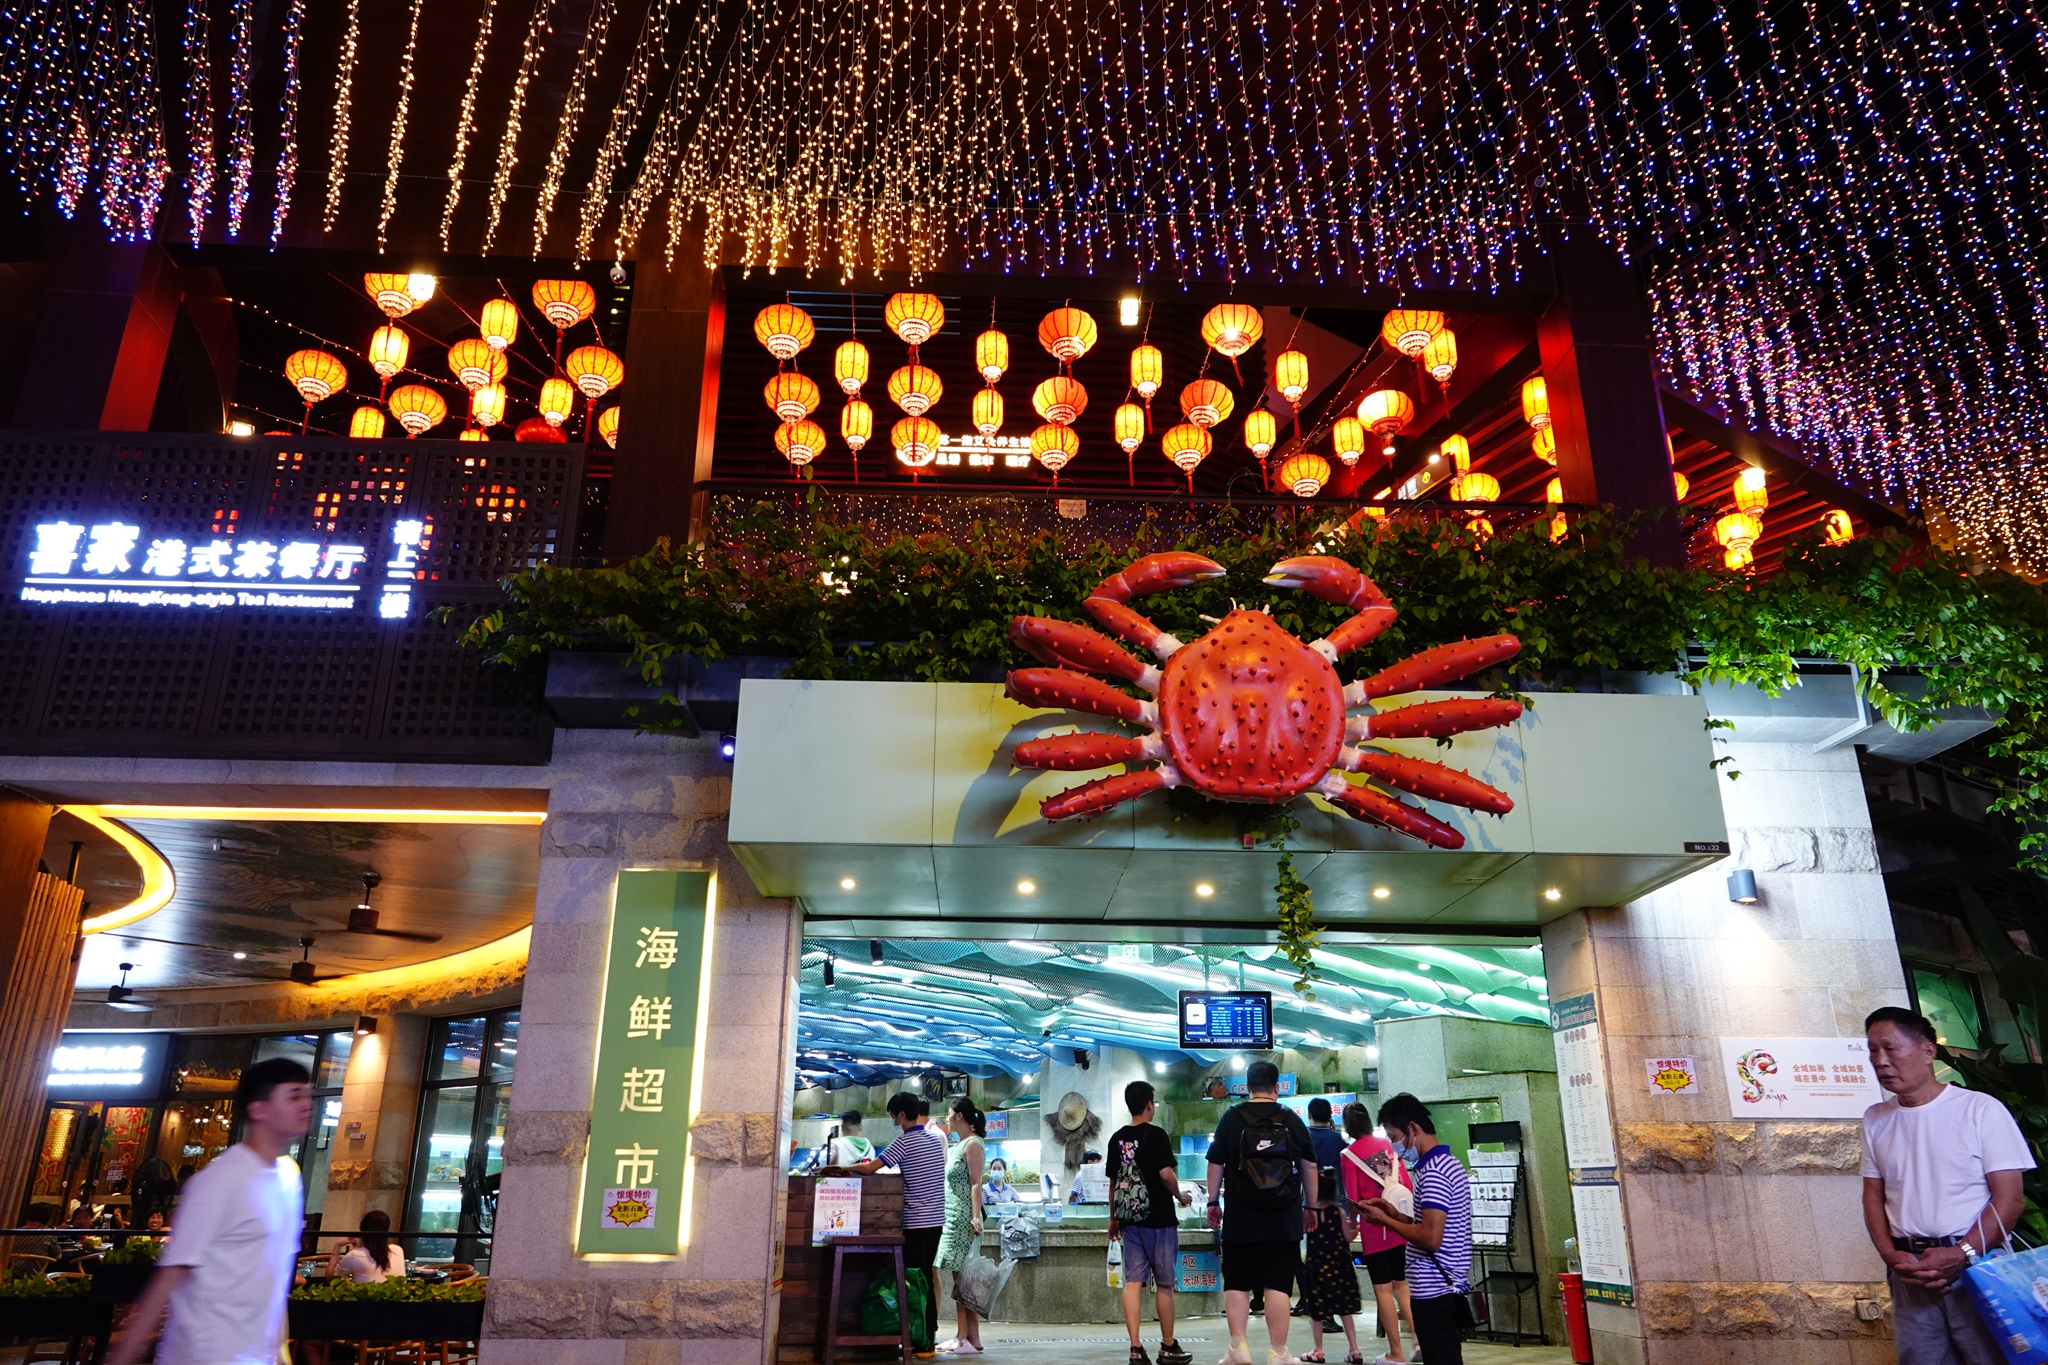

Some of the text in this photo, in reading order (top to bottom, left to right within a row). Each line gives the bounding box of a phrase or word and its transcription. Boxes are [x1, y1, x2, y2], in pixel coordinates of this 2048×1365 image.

[21, 587, 106, 604] Happiness
[238, 592, 265, 606] Tea
[267, 592, 354, 609] Restaurant
[615, 926, 679, 1189] 海鲜超市
[1656, 1060, 1688, 1068] 惊爆特价
[1793, 1064, 1864, 1073] 全域如画 全域如景
[1834, 1074, 1866, 1083] 景城融合
[616, 1190, 651, 1199] 惊爆特价
[1182, 1253, 1196, 1268] A区
